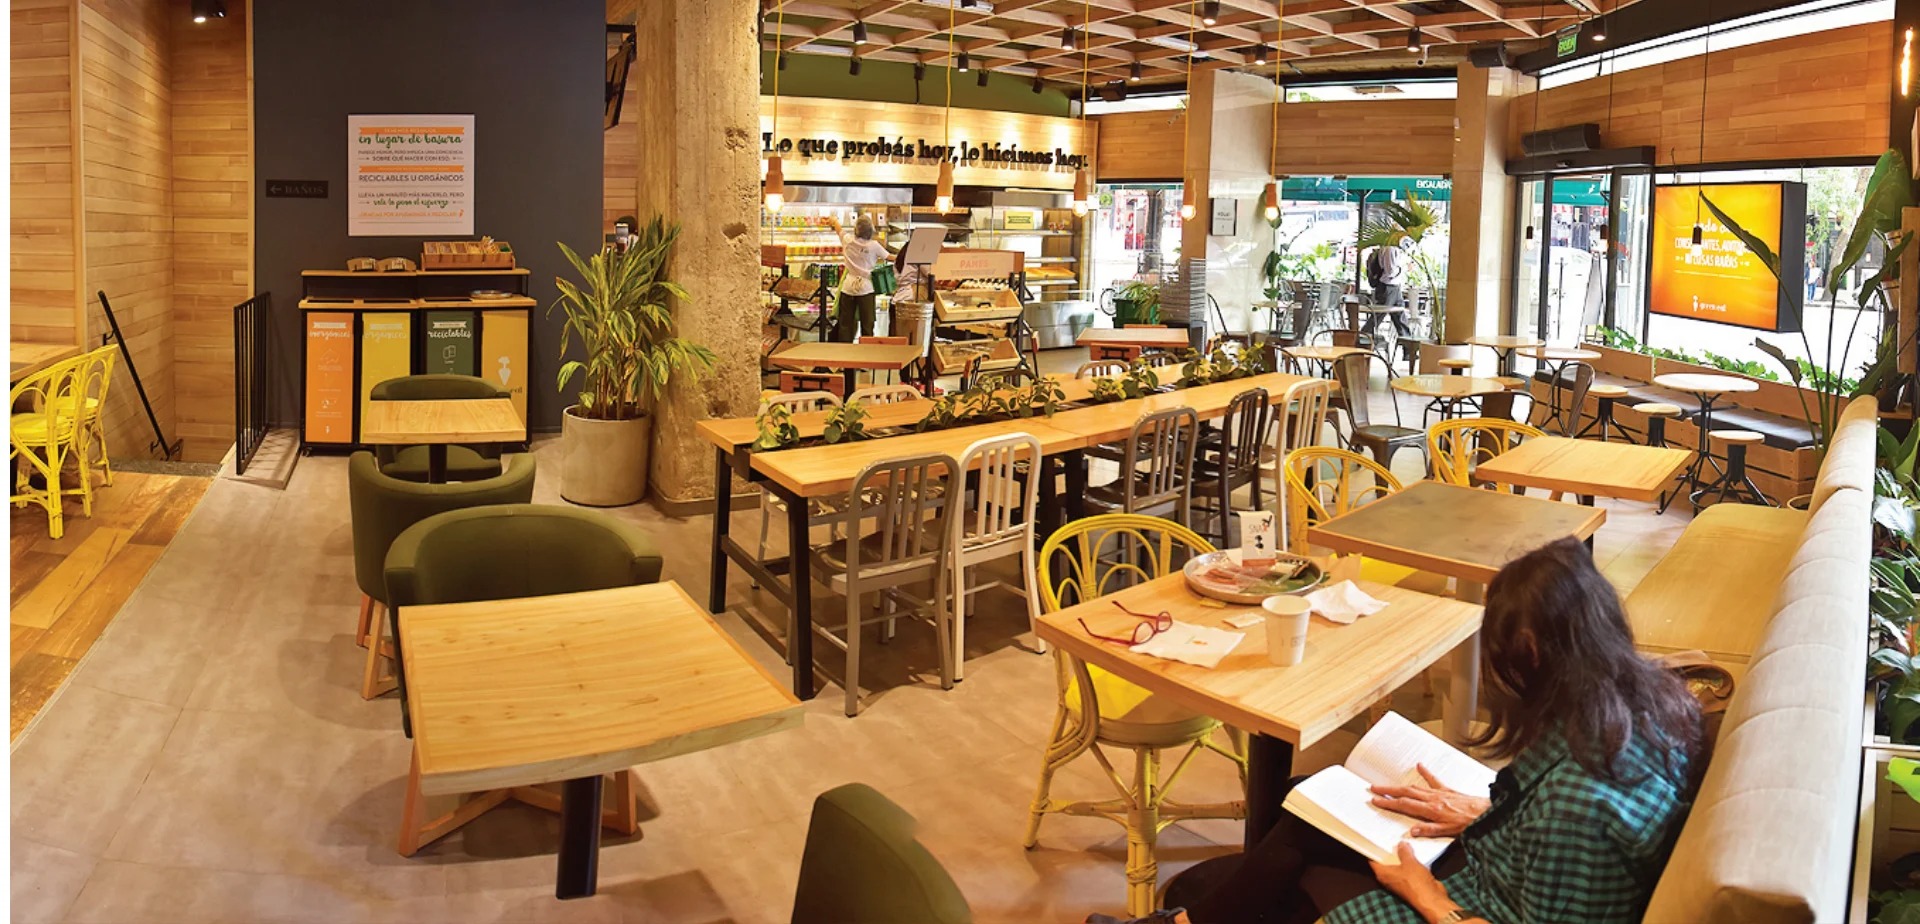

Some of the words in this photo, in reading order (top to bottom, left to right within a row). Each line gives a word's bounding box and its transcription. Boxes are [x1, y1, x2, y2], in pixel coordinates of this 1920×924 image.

[359, 136, 371, 145] en
[375, 132, 406, 149] lugar
[408, 133, 423, 144] de
[424, 133, 463, 144] basura
[797, 138, 839, 158] que
[842, 136, 915, 159] probás
[917, 139, 958, 164] hoy,
[961, 141, 980, 161] lo
[359, 174, 409, 182] RECICLABLES
[418, 173, 464, 181] ORGÁNICOS
[427, 327, 472, 339] reciclables
